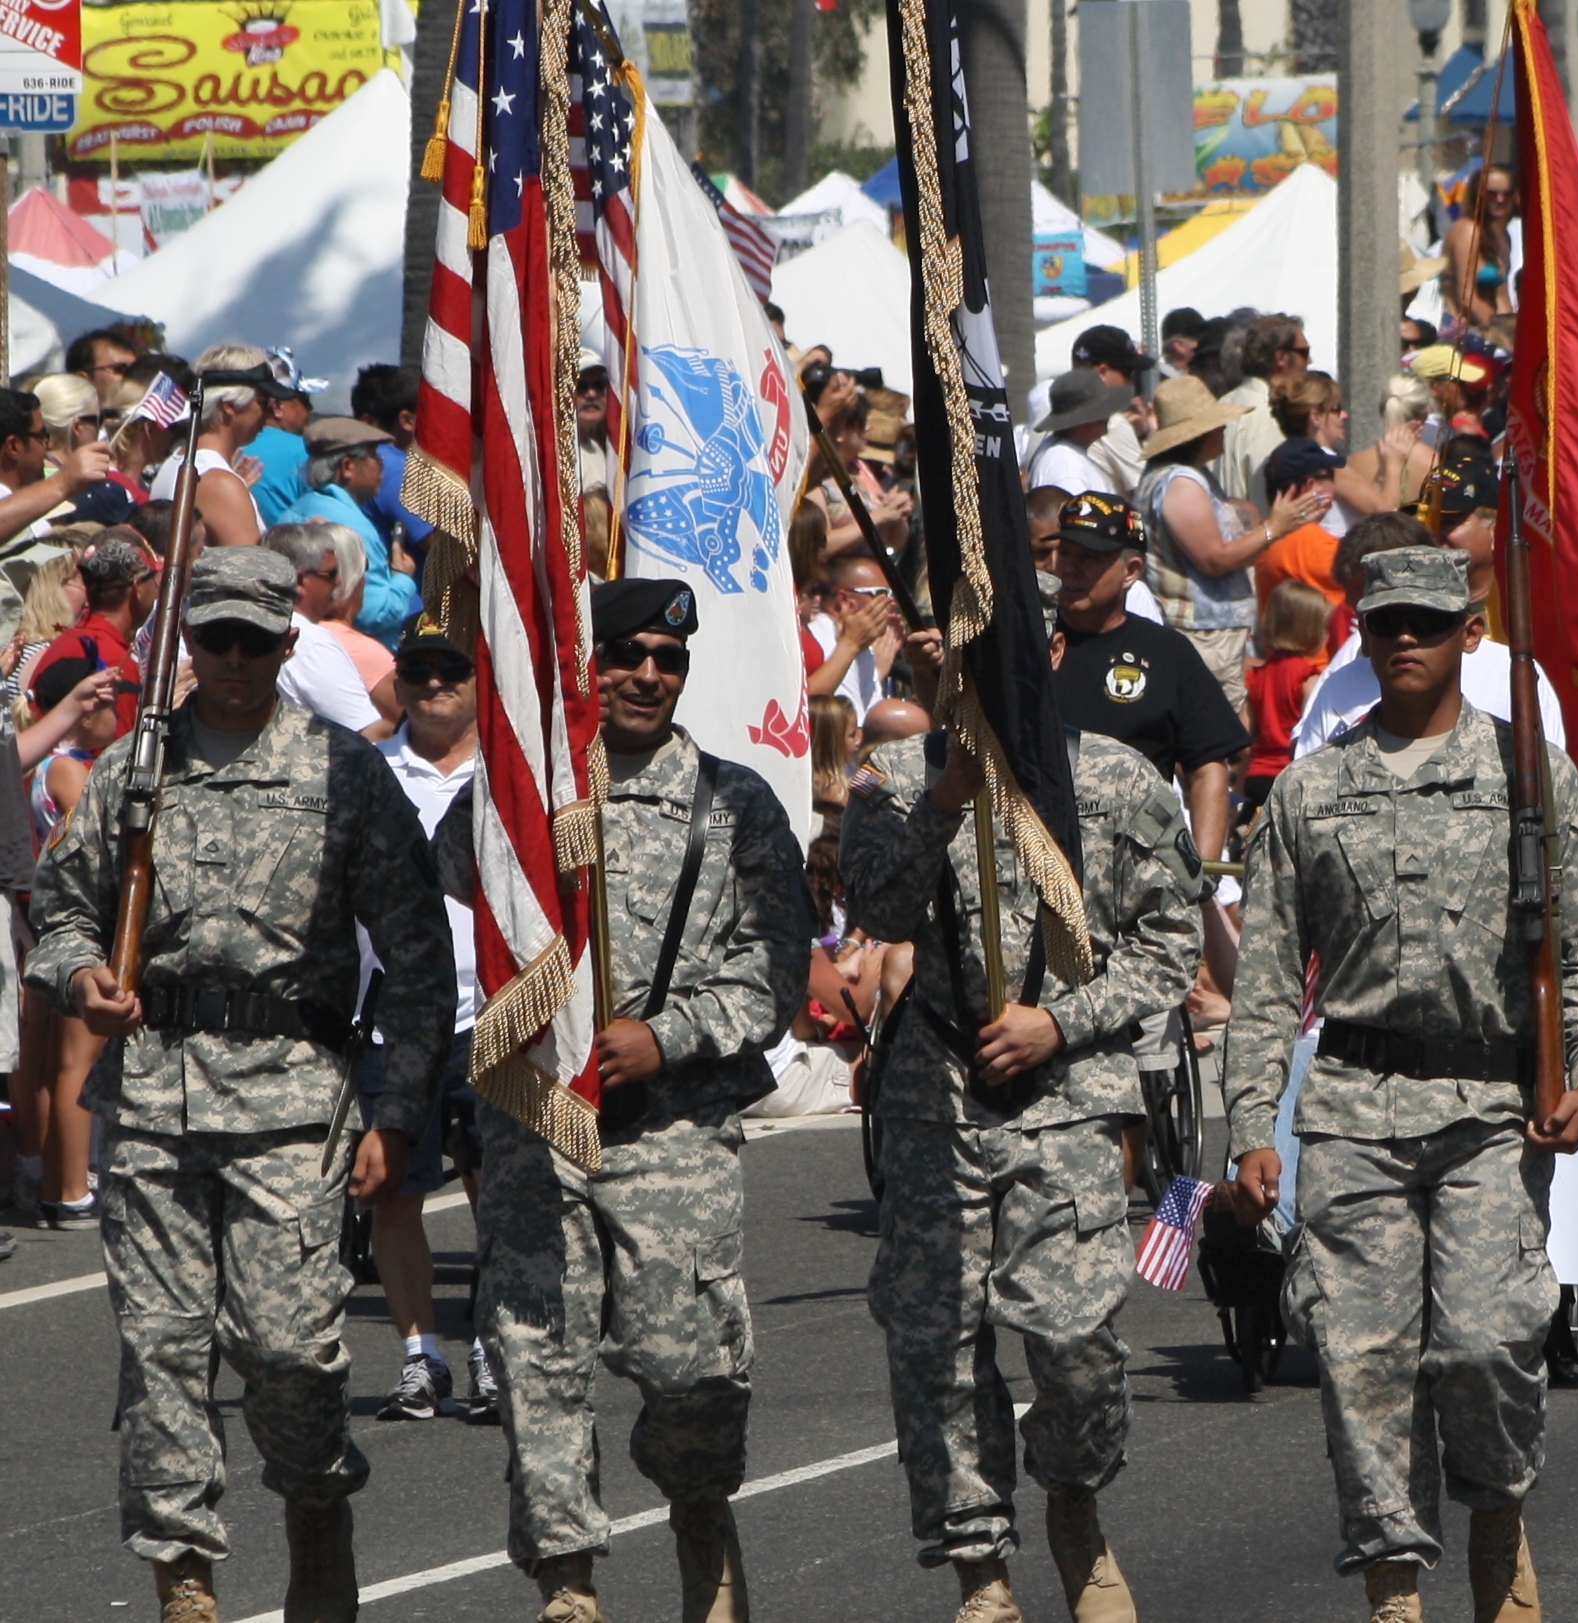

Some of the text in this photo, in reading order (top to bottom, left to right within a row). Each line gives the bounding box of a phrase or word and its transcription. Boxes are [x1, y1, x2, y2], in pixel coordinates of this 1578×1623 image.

[23, 77, 76, 90] 636-RIDE
[293, 795, 329, 810] ARMY
[1317, 801, 1368, 816] ANGUIANO
